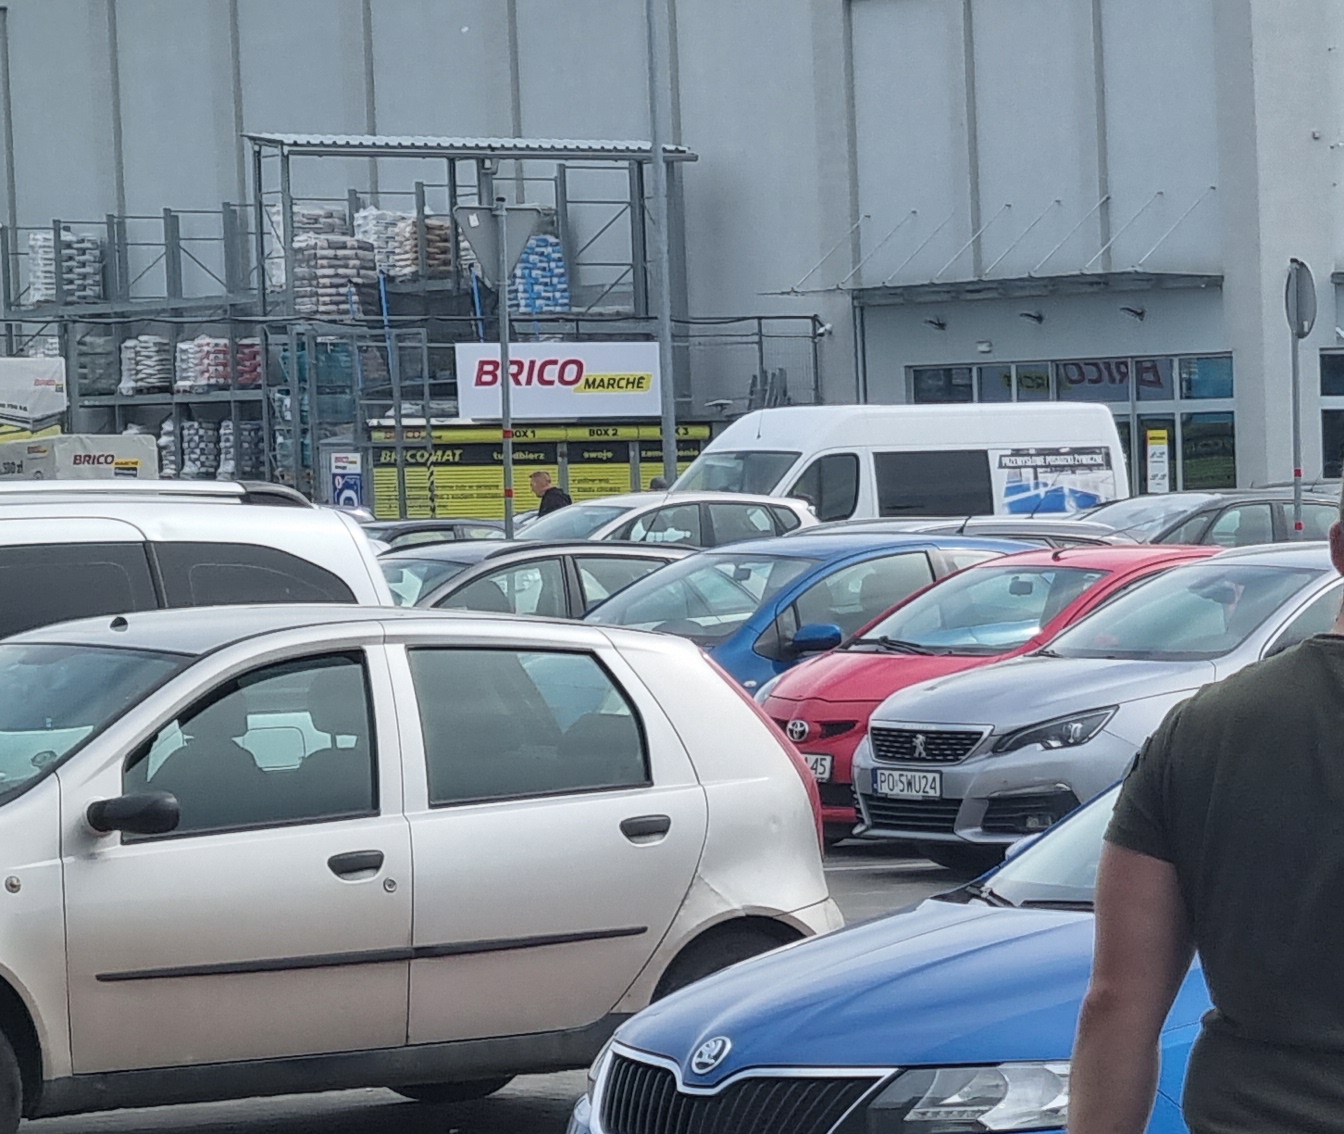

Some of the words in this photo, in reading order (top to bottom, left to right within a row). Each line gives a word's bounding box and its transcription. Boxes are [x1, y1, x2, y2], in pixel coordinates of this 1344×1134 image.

[474, 359, 585, 387] BRICO
[531, 429, 537, 438] 1
[588, 428, 610, 437] BOX
[611, 428, 619, 437] 2
[682, 428, 689, 436] 3
[73, 454, 115, 466] BRICO
[511, 451, 546, 460] dbierz
[879, 772, 895, 791] PO
[898, 773, 937, 795] 5WU24
